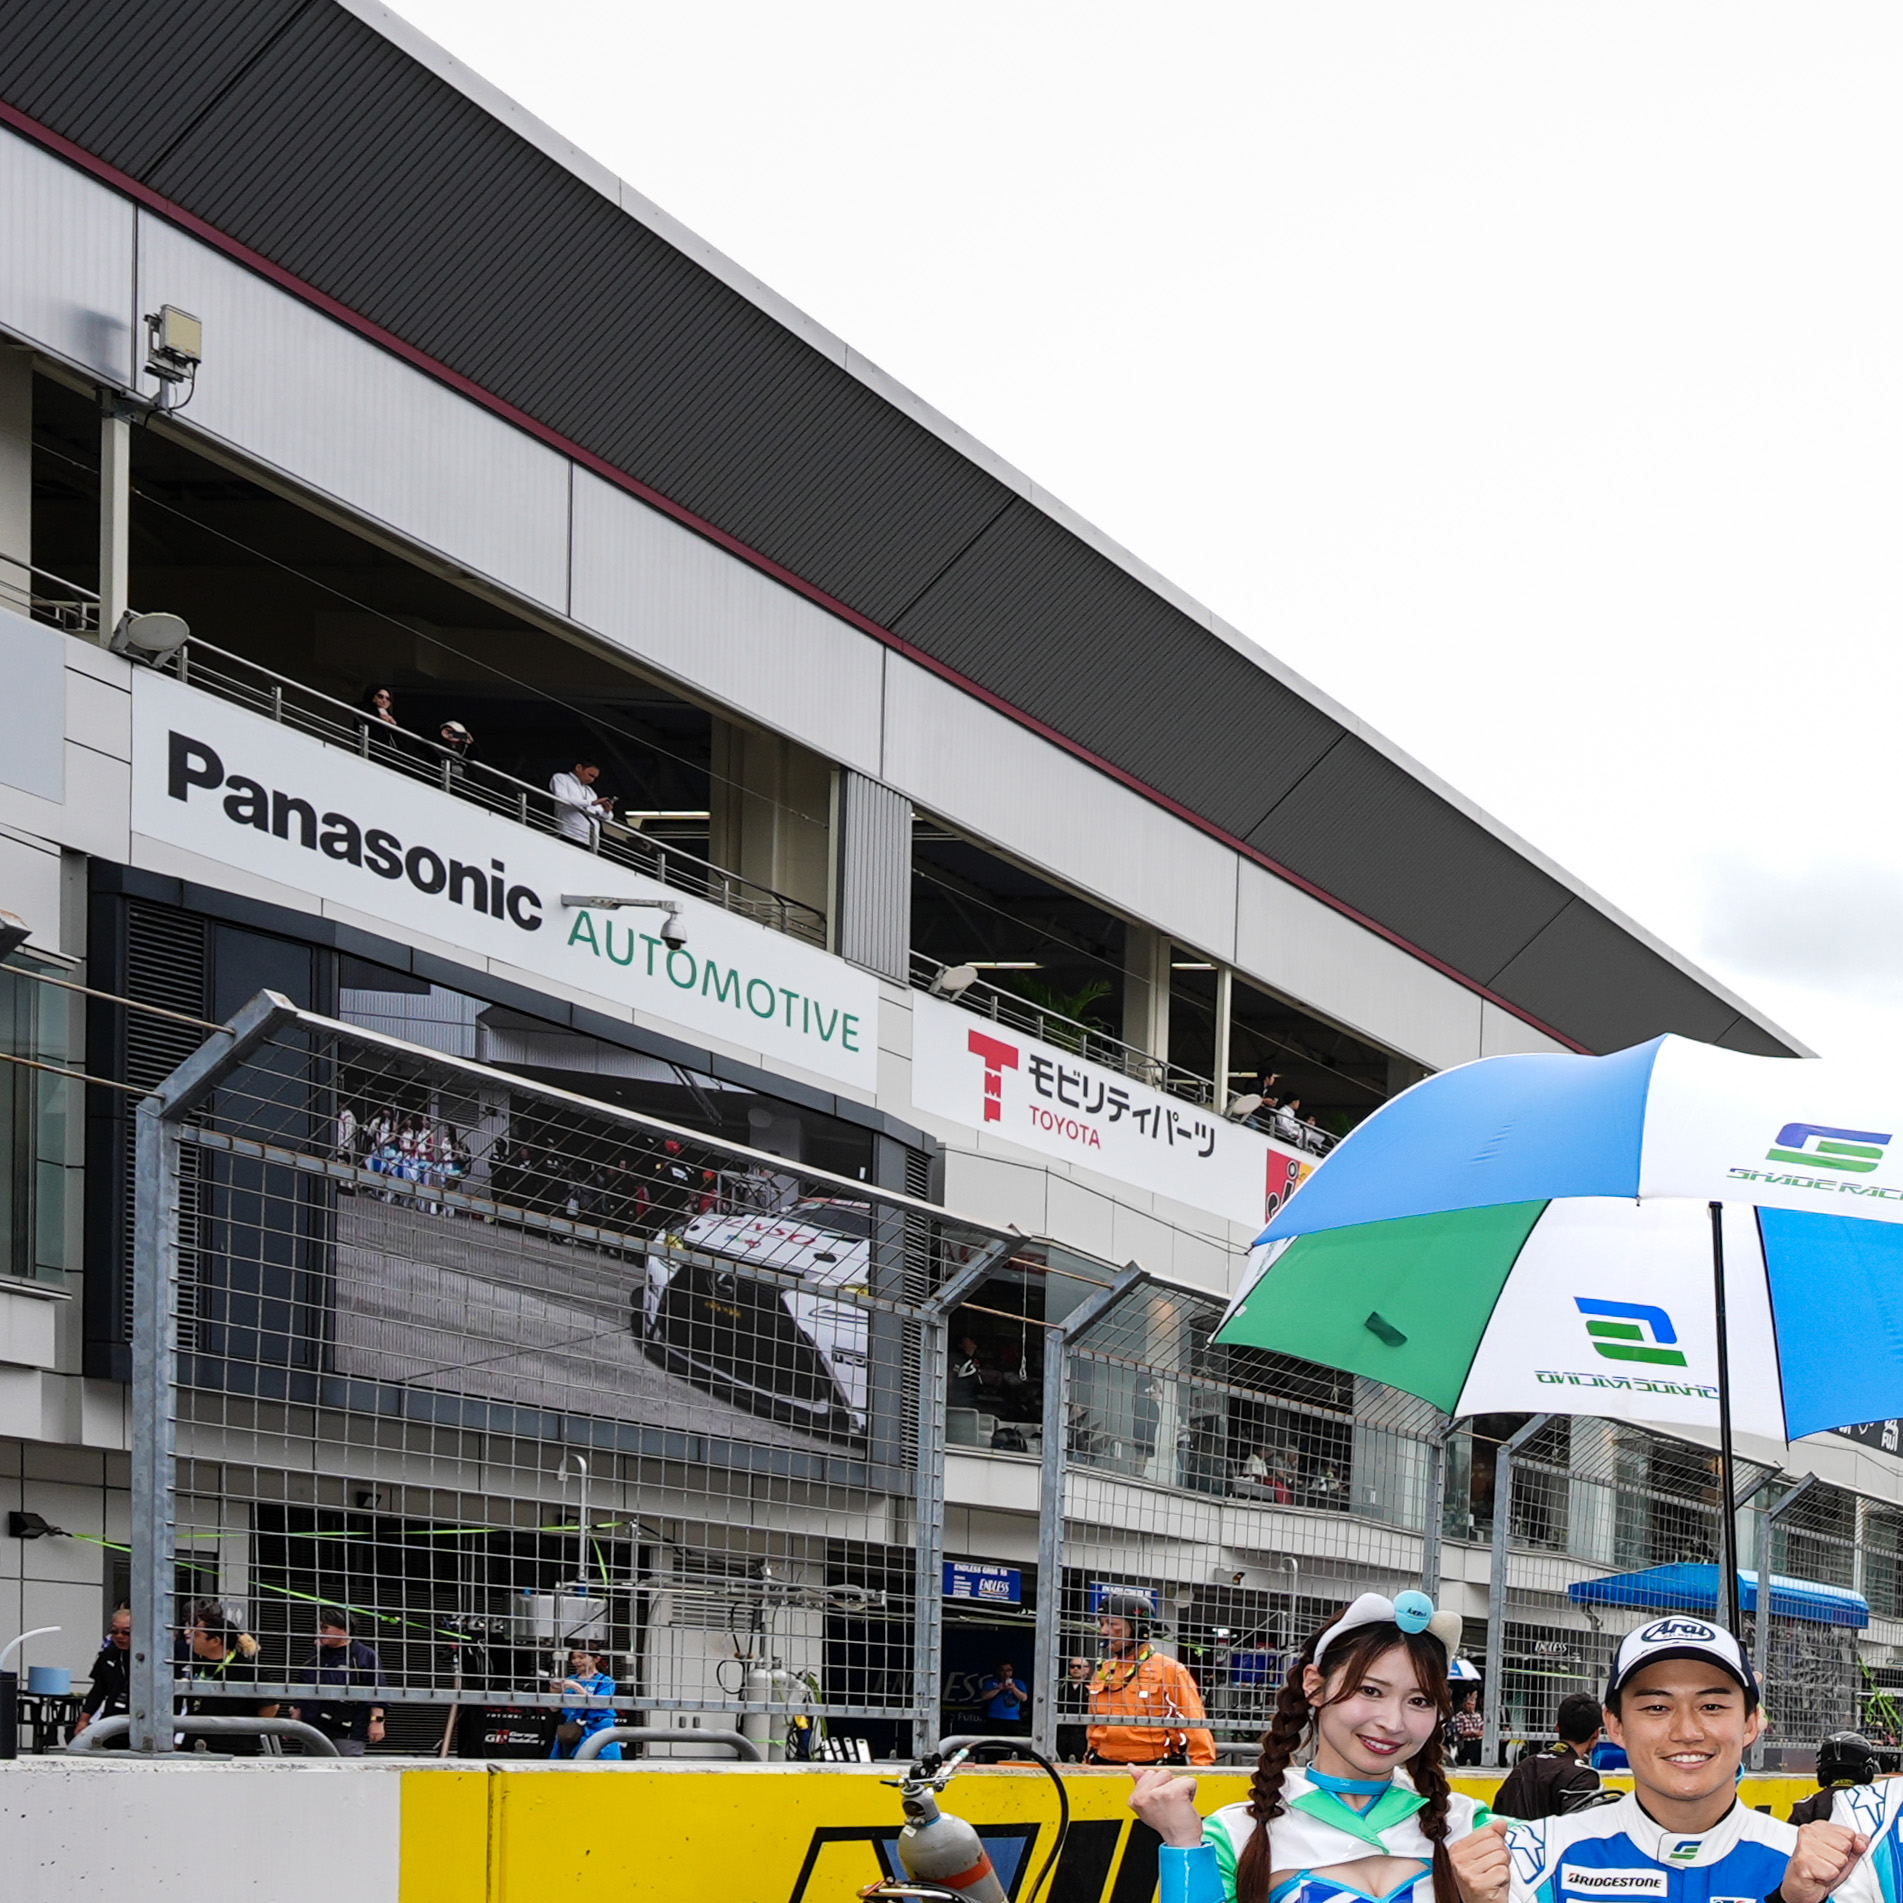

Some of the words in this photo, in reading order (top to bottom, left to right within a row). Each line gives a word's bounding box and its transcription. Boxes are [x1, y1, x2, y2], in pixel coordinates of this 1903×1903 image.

[167, 730, 544, 932] Panasonic
[567, 910, 860, 1054] AUTOMOTIVE
[1028, 1053, 1216, 1157] モビリティパーツ
[1029, 1105, 1100, 1150] TOYOTA
[1657, 1618, 1707, 1636] Arai
[1568, 1872, 1662, 1889] BRIDGESTONE
